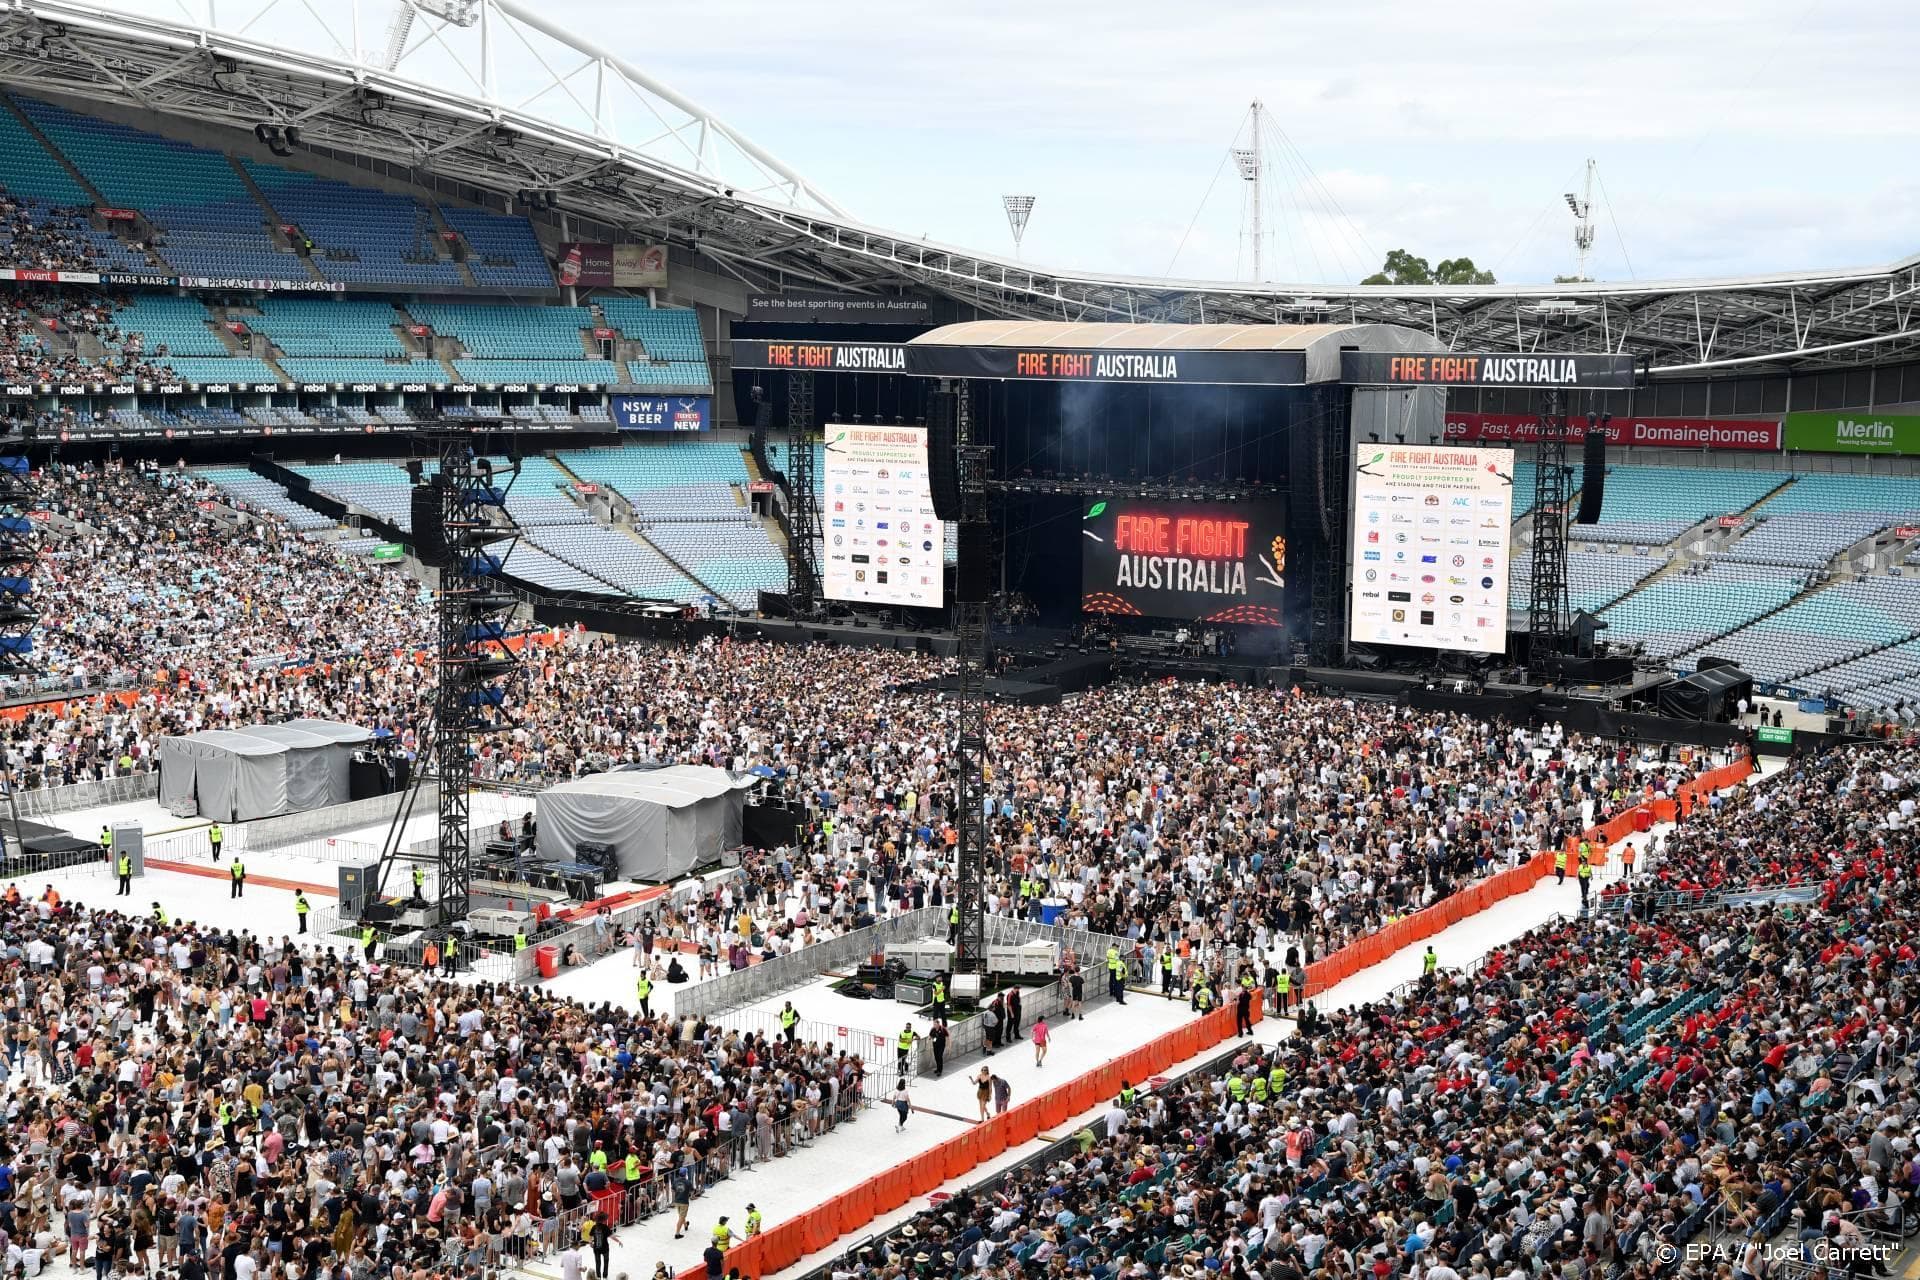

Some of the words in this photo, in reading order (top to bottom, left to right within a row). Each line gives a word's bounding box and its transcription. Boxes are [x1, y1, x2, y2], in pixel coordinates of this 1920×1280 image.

[586, 259, 610, 267] Home
[615, 260, 636, 269] Away
[23, 271, 51, 281] vivant
[110, 275, 137, 285] MARS
[140, 276, 169, 286] MARS
[208, 278, 250, 289] PRECAST
[290, 281, 332, 291] PRECAST
[752, 299, 769, 307] See
[771, 299, 785, 307] the
[787, 299, 806, 308] best
[808, 299, 844, 310] sporting
[847, 301, 875, 309] events
[877, 300, 885, 309] in
[887, 301, 927, 310] Australia
[768, 345, 794, 366] FIRE
[798, 346, 833, 367] FIGHT
[836, 347, 905, 369] AUSTRALIA
[1017, 353, 1048, 376] FIRE
[1052, 354, 1093, 376] FIGHT
[1096, 355, 1177, 378] AUSTRALIA
[1391, 357, 1426, 381] FIRE
[1431, 357, 1479, 382] FIGHT
[1482, 358, 1577, 383] AUSTRALIA
[7, 384, 32, 395] rebel
[60, 384, 85, 395] rebel
[111, 384, 135, 394] rebel
[160, 383, 183, 394] rebel
[206, 383, 230, 393] rebel
[255, 383, 278, 393] rebel
[303, 383, 327, 393] rebel
[352, 383, 377, 393] rebel
[402, 383, 427, 392] rebel
[453, 383, 477, 392] rebel
[504, 383, 528, 392] rebel
[555, 383, 579, 393] rebel
[622, 401, 652, 412] NSW
[656, 402, 668, 413] #1
[629, 413, 662, 424] BEER
[674, 421, 700, 430] NEW
[1481, 422, 1511, 436] Fast,
[1837, 420, 1894, 439] Merlin
[850, 431, 863, 441] FIRE
[864, 431, 882, 442] FIGHT
[883, 432, 918, 443] AUSTRALIA
[1634, 423, 1769, 443] Domainehomes
[1390, 451, 1408, 463] FIRE
[1409, 452, 1432, 464] FIGHT
[1433, 453, 1478, 466] AUSTRALIA
[1392, 473, 1422, 481] PROUDLY
[1424, 474, 1464, 482] SUPPORTED
[1116, 515, 1170, 553] FIRE
[1176, 518, 1249, 558] FIGHT
[1116, 554, 1247, 595] AUSTRALIA
